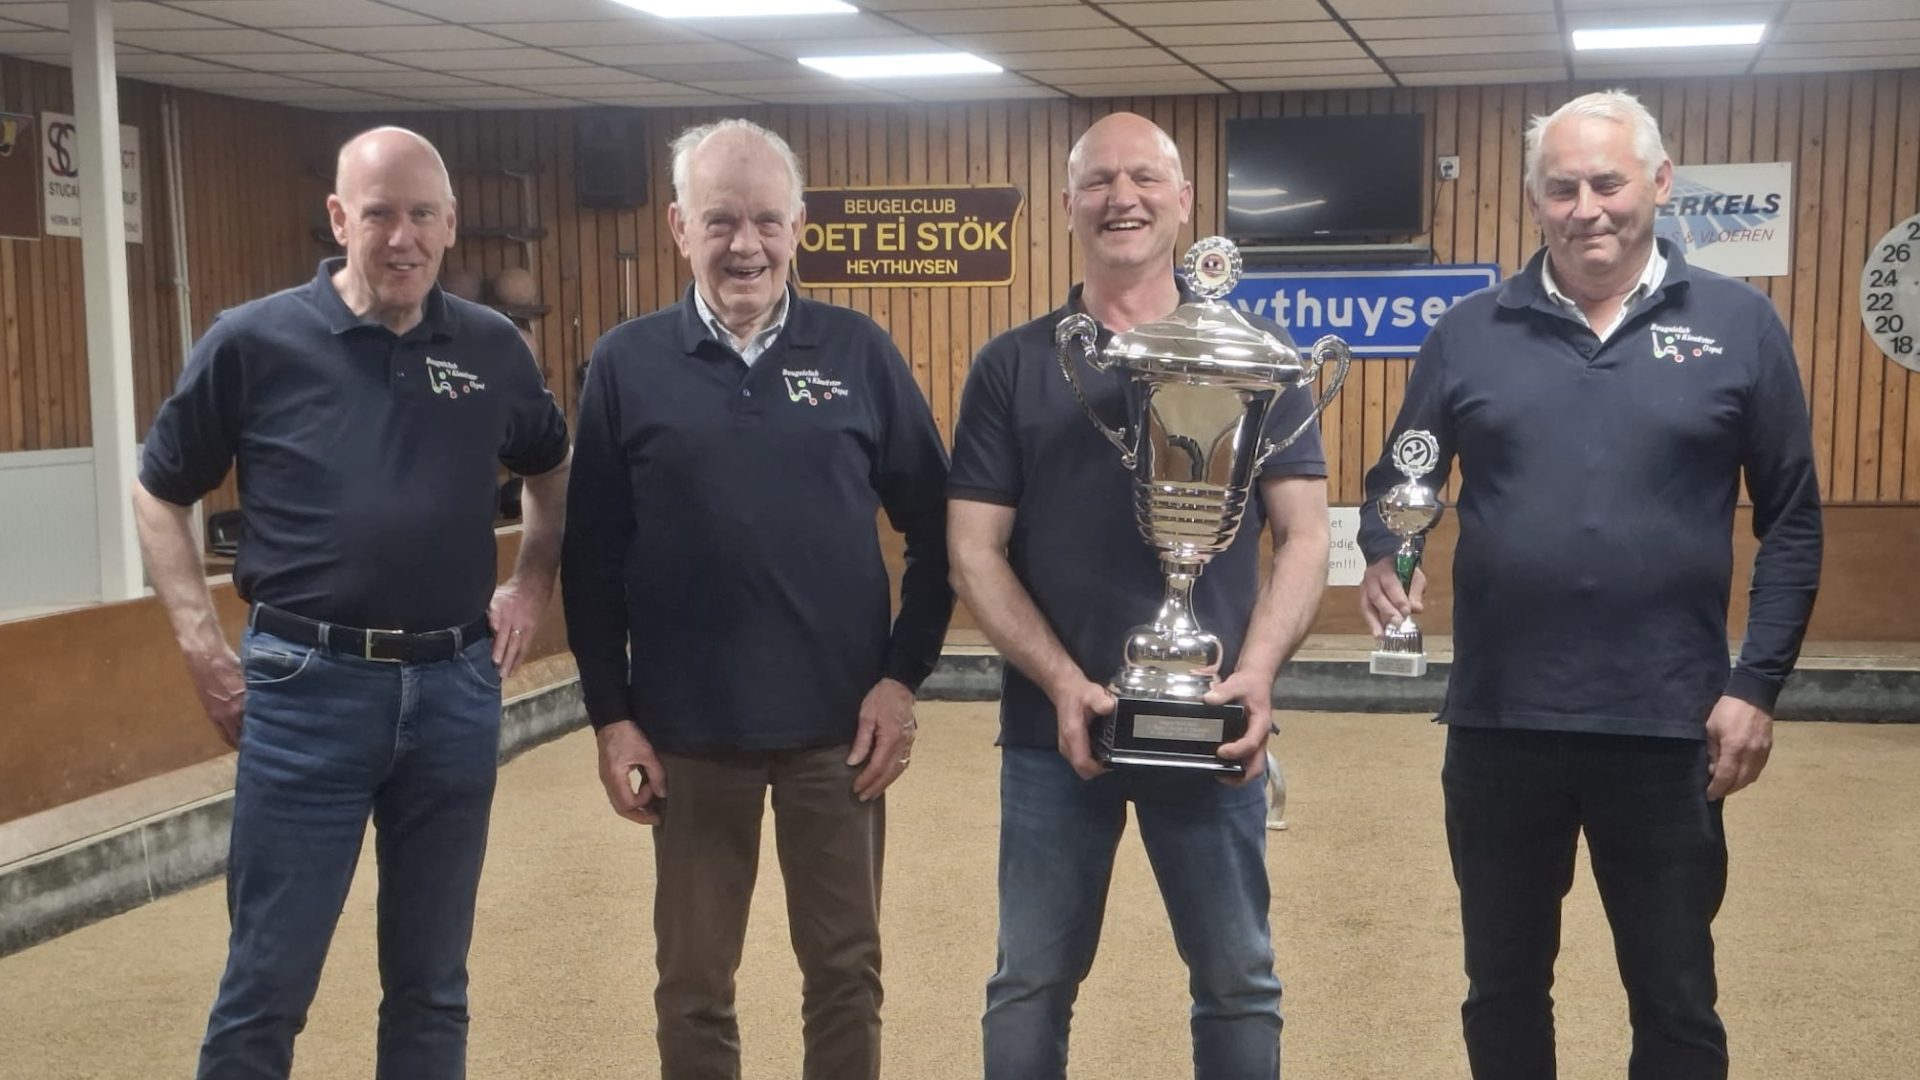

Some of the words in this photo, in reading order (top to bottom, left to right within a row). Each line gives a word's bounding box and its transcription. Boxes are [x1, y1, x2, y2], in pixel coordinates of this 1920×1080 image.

[844, 198, 956, 215] BEUGELCLUB
[1657, 193, 1781, 216] ERKELS
[802, 222, 868, 252] OET
[917, 216, 1008, 252] STÖK
[1701, 229, 1775, 243] VLOEREN
[1907, 222, 1920, 240] 2
[1883, 244, 1911, 262] 26
[846, 259, 959, 275] HEYTHUYSEN
[1870, 269, 1898, 288] 24
[1867, 292, 1893, 311] 22
[1236, 287, 1463, 336] ythuyse
[1875, 314, 1904, 333] 20
[1890, 335, 1913, 354] 18
[1331, 520, 1342, 528] et
[1329, 538, 1354, 550] odig
[1328, 558, 1356, 569] en!!!
